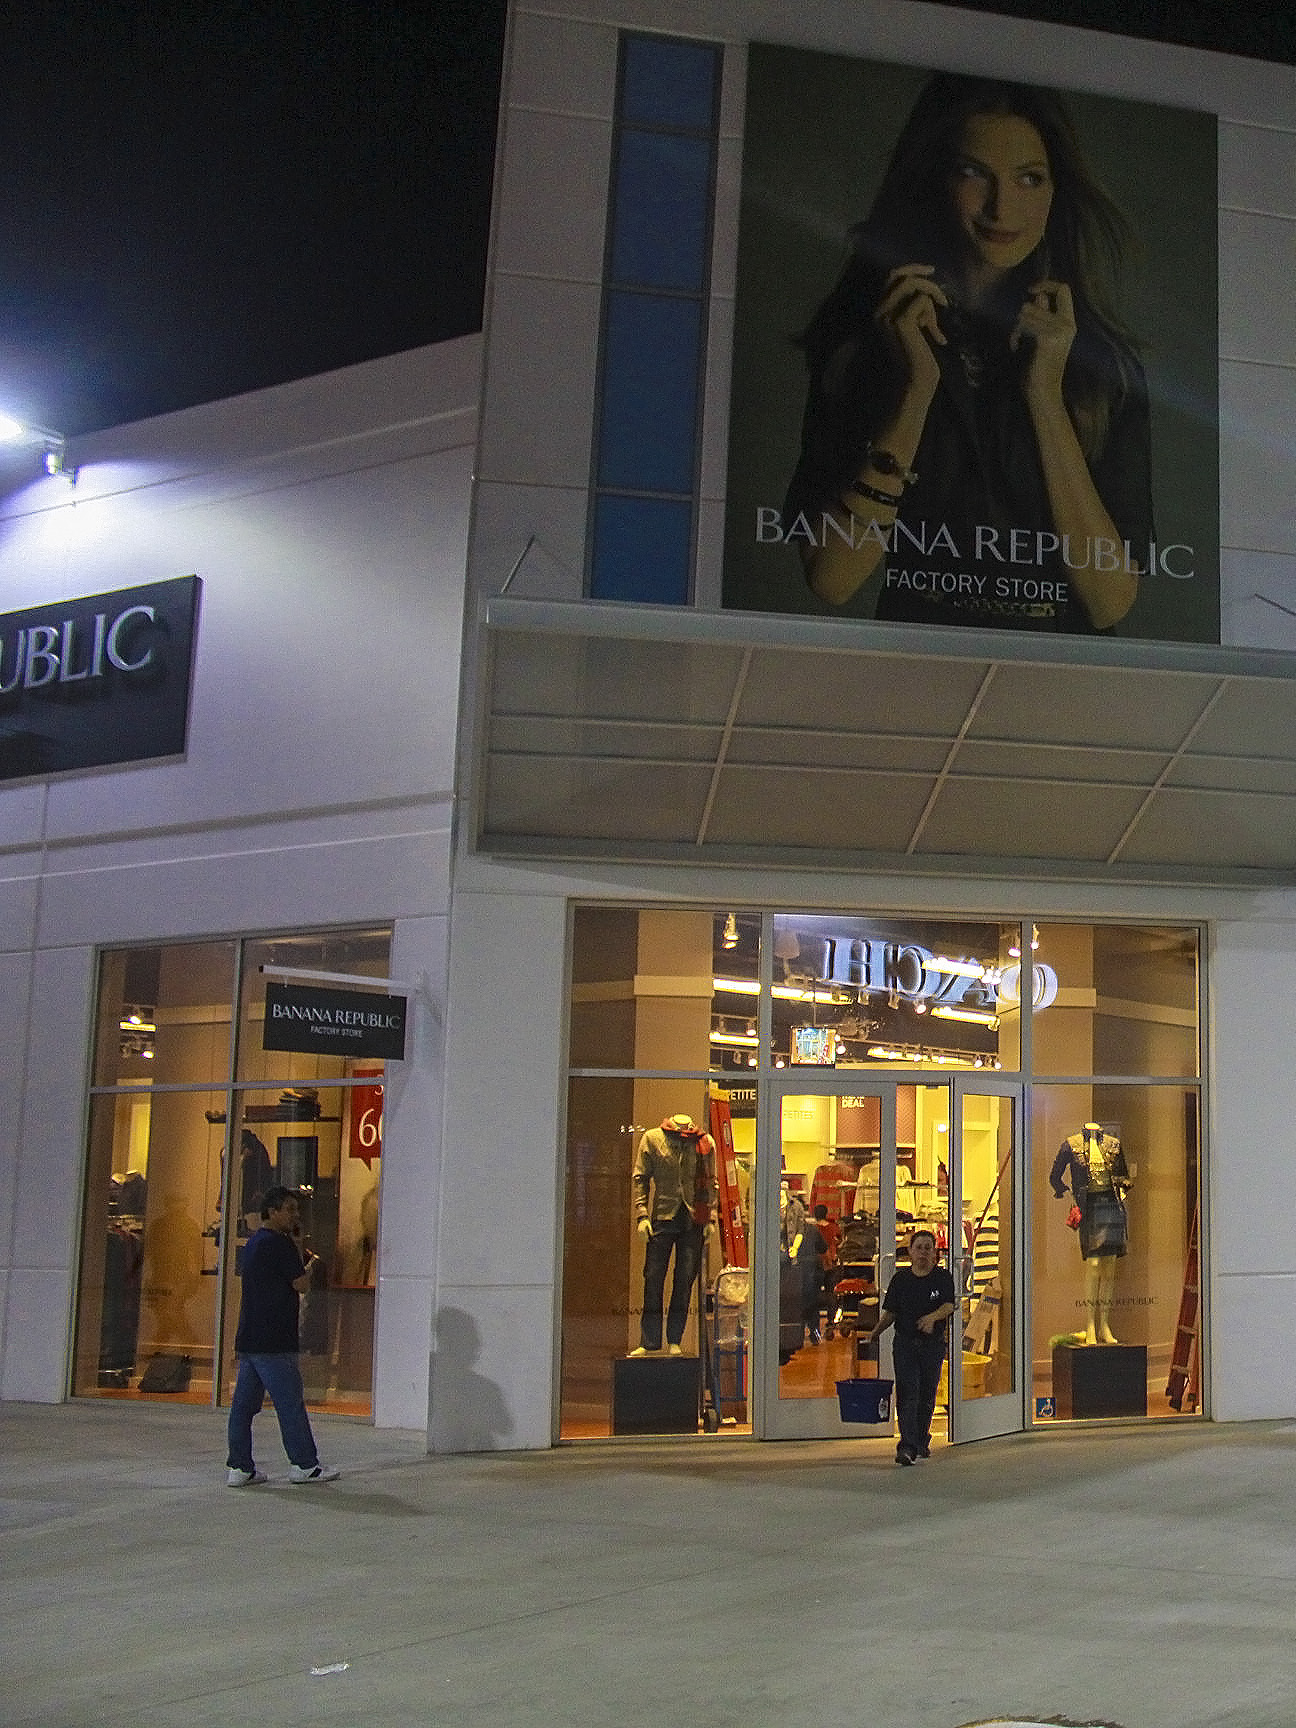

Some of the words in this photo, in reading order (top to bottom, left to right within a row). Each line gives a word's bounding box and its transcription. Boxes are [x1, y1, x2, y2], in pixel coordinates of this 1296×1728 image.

[755, 506, 961, 559] BANANA
[975, 525, 1196, 579] REPUBLIC
[886, 567, 987, 595] FACTORY
[995, 576, 1069, 602] STORE
[272, 1003, 332, 1023] BANANA
[335, 1009, 401, 1029] REPUBLIC
[310, 1025, 340, 1036] FACTORY
[341, 1027, 363, 1038] STORE
[728, 1089, 757, 1101] ETITE
[841, 1098, 865, 1108] DEAL
